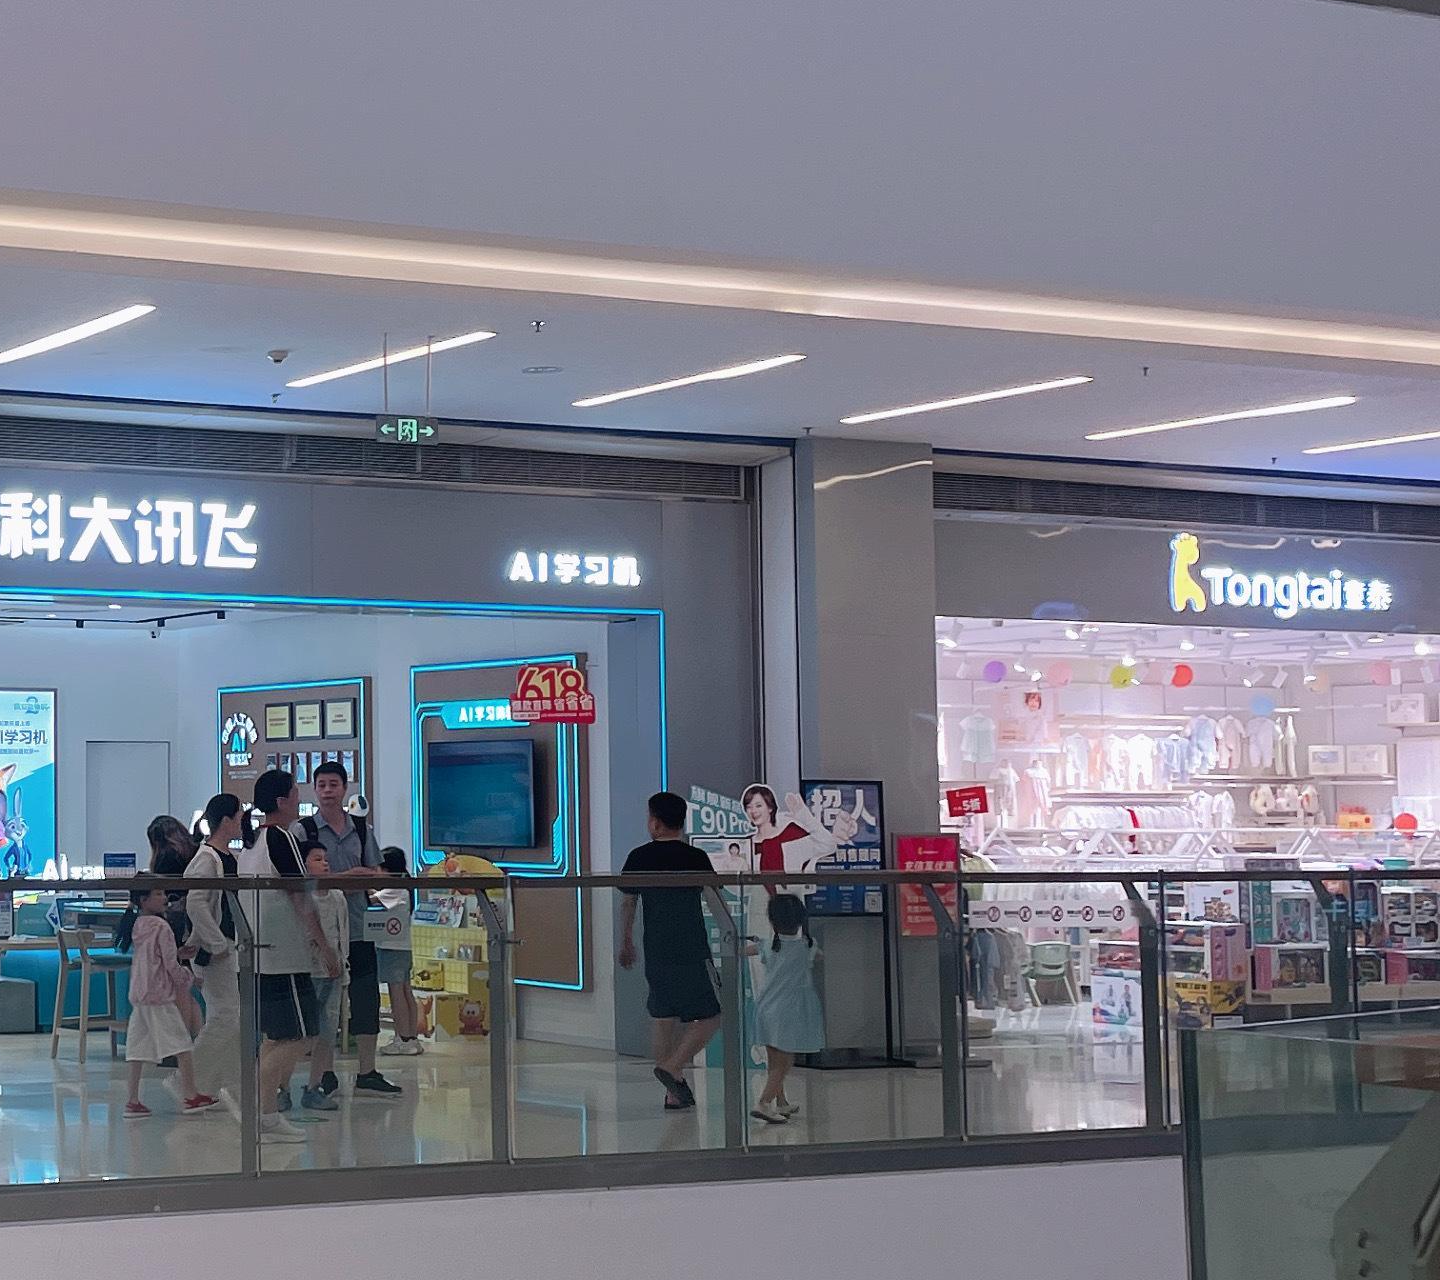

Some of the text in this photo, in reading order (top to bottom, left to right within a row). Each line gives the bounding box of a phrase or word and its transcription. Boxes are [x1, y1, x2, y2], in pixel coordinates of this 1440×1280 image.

[508, 551, 642, 587] AI学习机
[1200, 568, 1343, 619] Tongtai
[517, 667, 585, 699] 618
